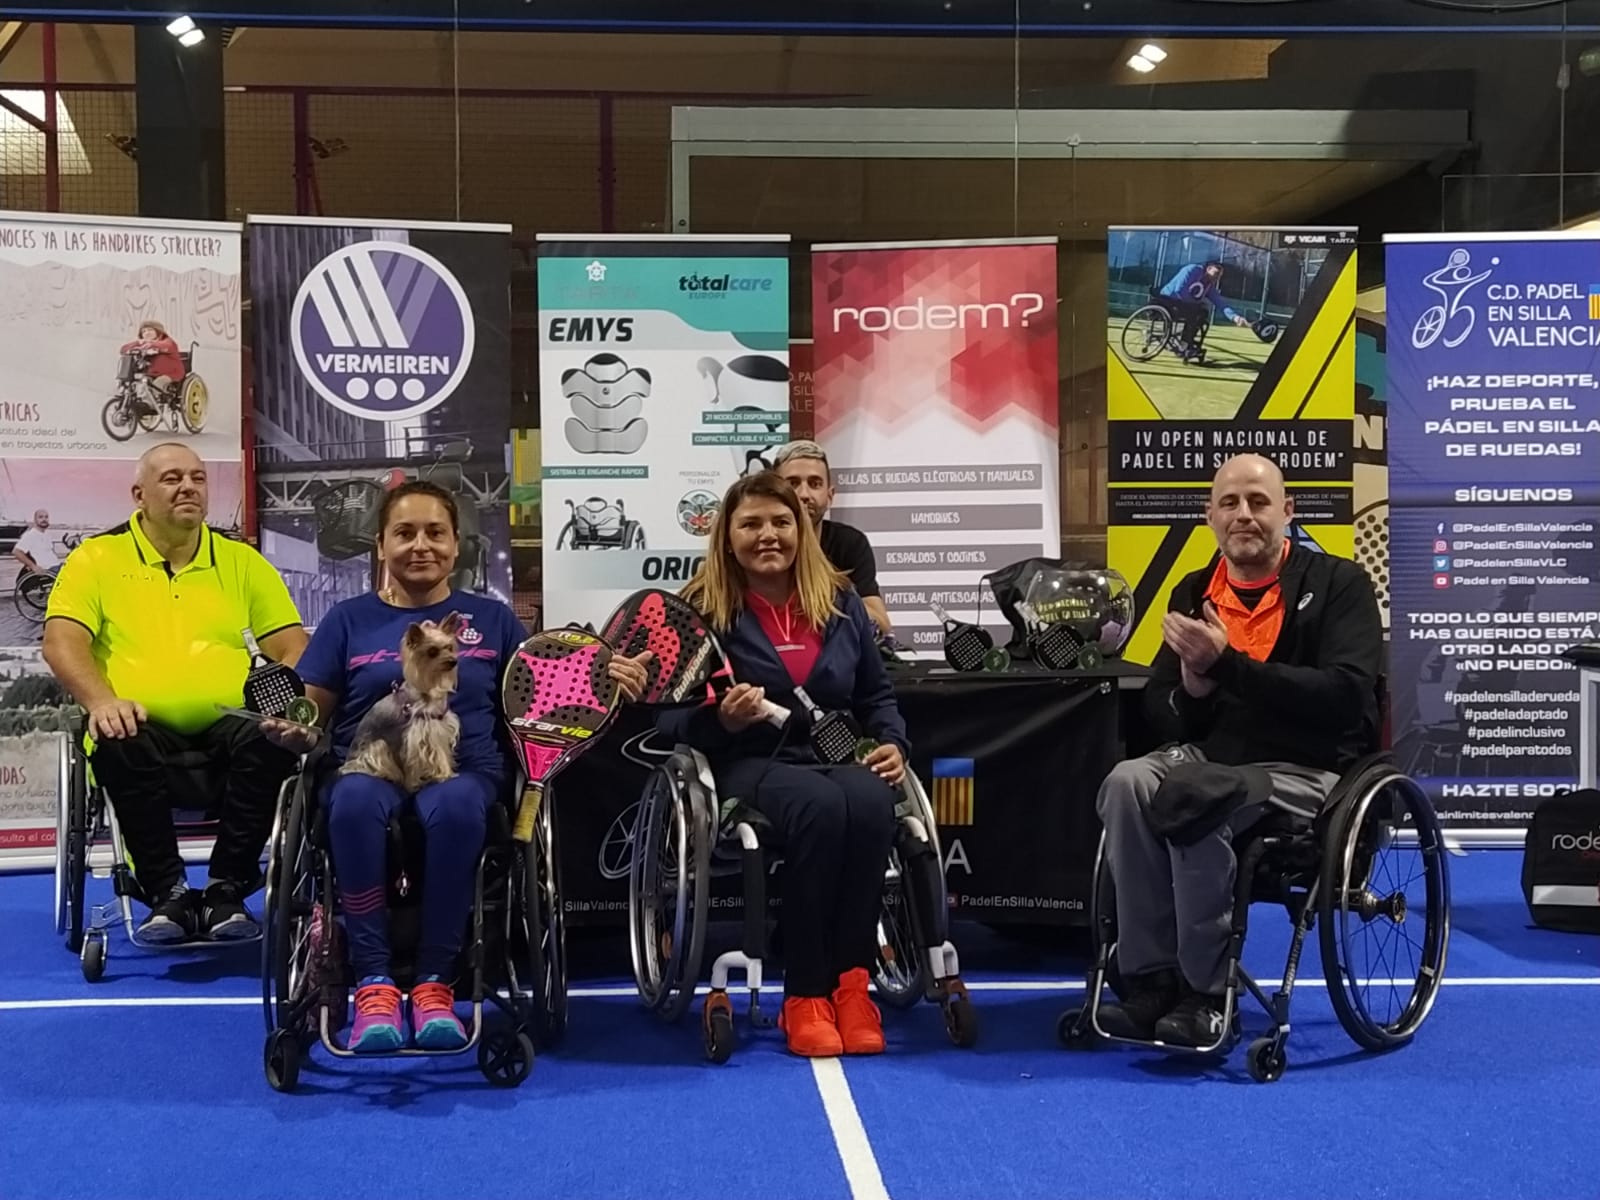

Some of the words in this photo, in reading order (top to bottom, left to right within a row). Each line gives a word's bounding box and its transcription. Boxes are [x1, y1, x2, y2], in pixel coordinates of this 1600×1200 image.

[41, 231, 58, 250] YA
[65, 231, 88, 251] LAS
[93, 232, 157, 255] HANDBIKES
[161, 236, 223, 257] STRICKER?
[1487, 284, 1522, 300] C.D.
[1526, 283, 1585, 300] PADEL
[833, 293, 1043, 333] rodem?
[1488, 306, 1513, 321] EN
[1518, 305, 1572, 321] SILLA
[549, 317, 634, 342] EMYS
[315, 353, 450, 375] VERMEIREN
[1427, 375, 1482, 391] ¡HAZ
[1485, 374, 1599, 389] DEPORTE,
[1451, 398, 1545, 411] PRUEBA
[1549, 398, 1576, 410] EL
[1425, 418, 1499, 434] PÁDEL
[1503, 420, 1534, 433] EN
[1538, 420, 1600, 433] SILLA
[1136, 431, 1152, 446] IV
[1162, 431, 1204, 447] OPEN
[1213, 430, 1298, 446] NACIONAL
[1308, 430, 1328, 446] DE
[1446, 444, 1477, 457] DE
[1481, 443, 1581, 456] RUEDAS!
[1121, 453, 1175, 469] PADEL
[1184, 453, 1204, 469] EN
[838, 473, 869, 485] SILLAS
[872, 473, 883, 484] DE
[885, 472, 921, 485] RUEDAS
[979, 471, 986, 482] Y
[1455, 486, 1573, 502] SÍGUENOS
[1453, 523, 1593, 533] @PadelEnSillaValencia
[1453, 541, 1593, 551] @PadelEnSillaValencia
[886, 552, 937, 564] RESPALDOS
[939, 552, 945, 563] Y
[1454, 576, 1489, 585] Padel
[1508, 576, 1535, 585] Silla
[1536, 576, 1590, 585] Valencia
[885, 592, 928, 604] MATERIAL
[1407, 613, 1462, 624] TODO
[1465, 613, 1490, 624] LO
[1493, 613, 1534, 624] QUE
[1537, 612, 1600, 623] SIEMP
[1409, 628, 1451, 639] HAS
[1454, 628, 1542, 639] QUERIDO
[1545, 625, 1595, 639] ESTÁ
[1441, 644, 1495, 655] OTRO
[1498, 643, 1551, 655] LADO
[1464, 708, 1569, 723] #padeladaptado
[510, 717, 593, 738] starvie
[1468, 726, 1566, 740] #padelinclusivo
[1462, 744, 1572, 758] #padelparatodos
[1442, 784, 1519, 797] HAZTE
[961, 895, 1084, 910] PadelEnSillaValencia
